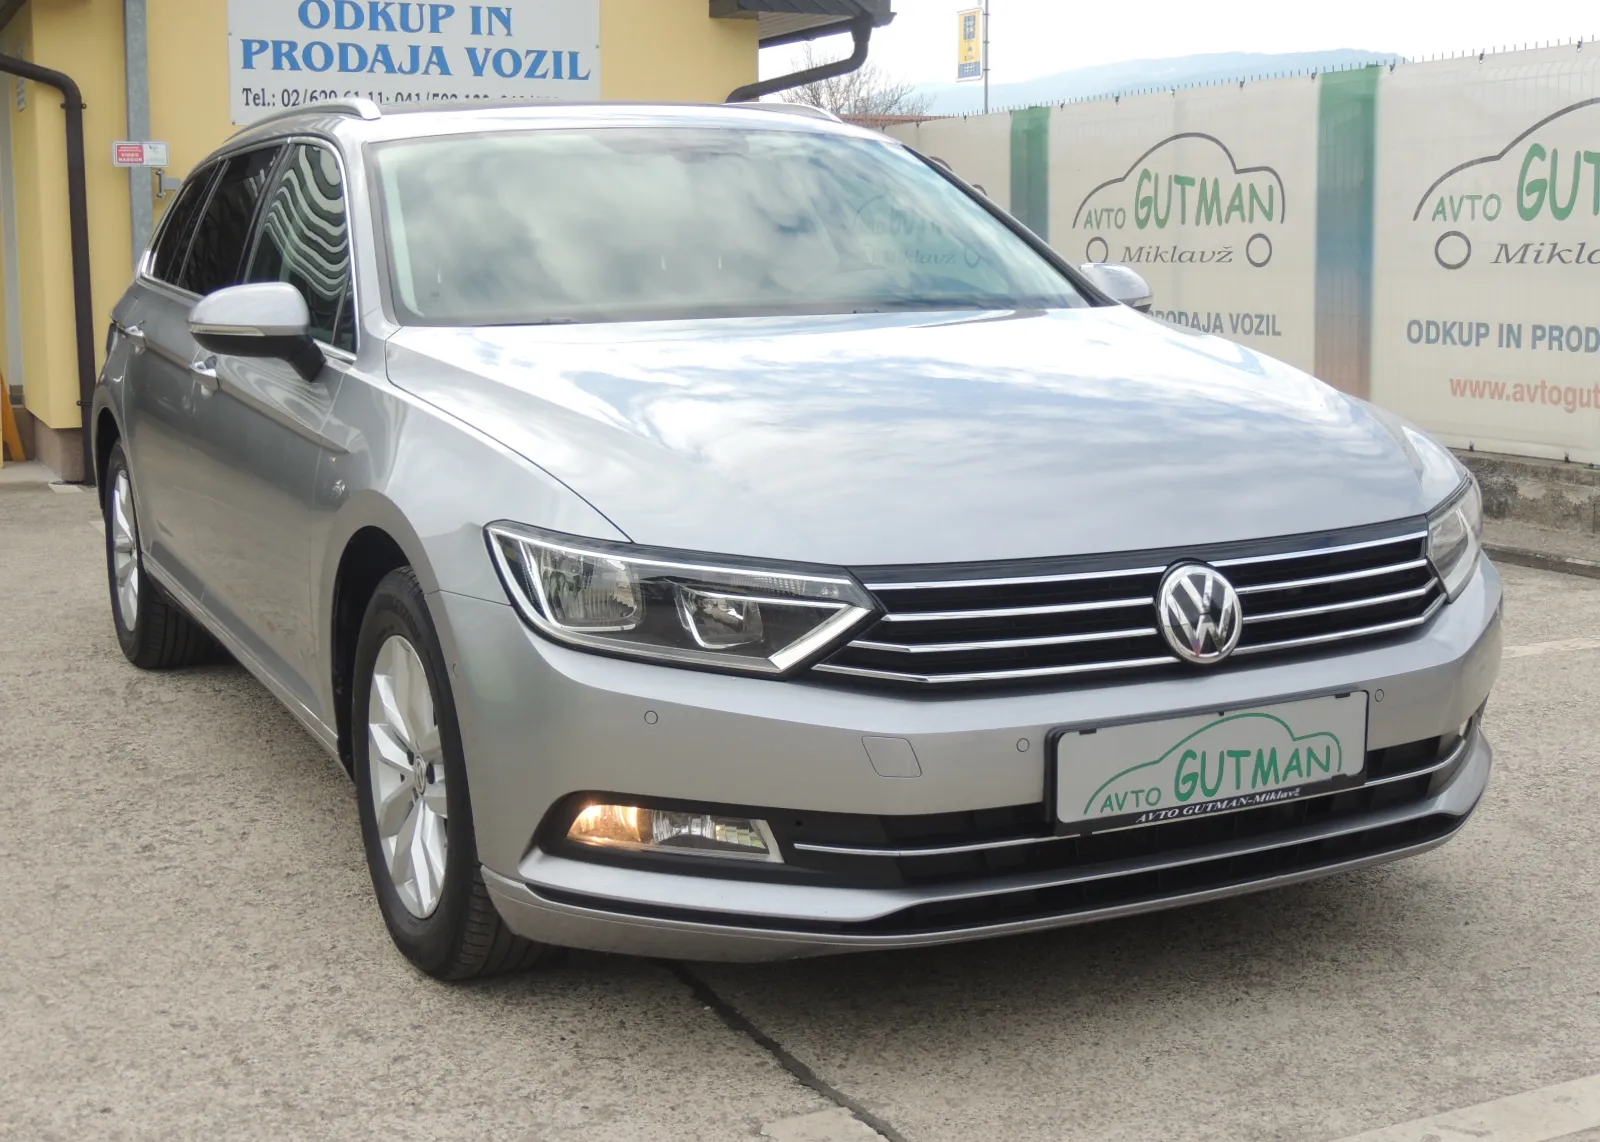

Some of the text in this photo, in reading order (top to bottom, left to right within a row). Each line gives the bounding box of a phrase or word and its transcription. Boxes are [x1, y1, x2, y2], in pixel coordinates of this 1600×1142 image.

[298, 0, 513, 37] ODKUP IN
[240, 38, 591, 81] PRODAJA VOZIL
[242, 88, 276, 107] Tel.:
[1084, 168, 1274, 230] AVTO GUTMAN
[1431, 193, 1502, 223] AVTO
[1119, 245, 1234, 264] Miklavž
[1229, 313, 1282, 337] VOZIL
[1406, 319, 1490, 347] ODKUP
[1497, 323, 1523, 349] IN
[1100, 745, 1331, 814] AVTO GUTMAN
[1135, 807, 1181, 824] AVTO
